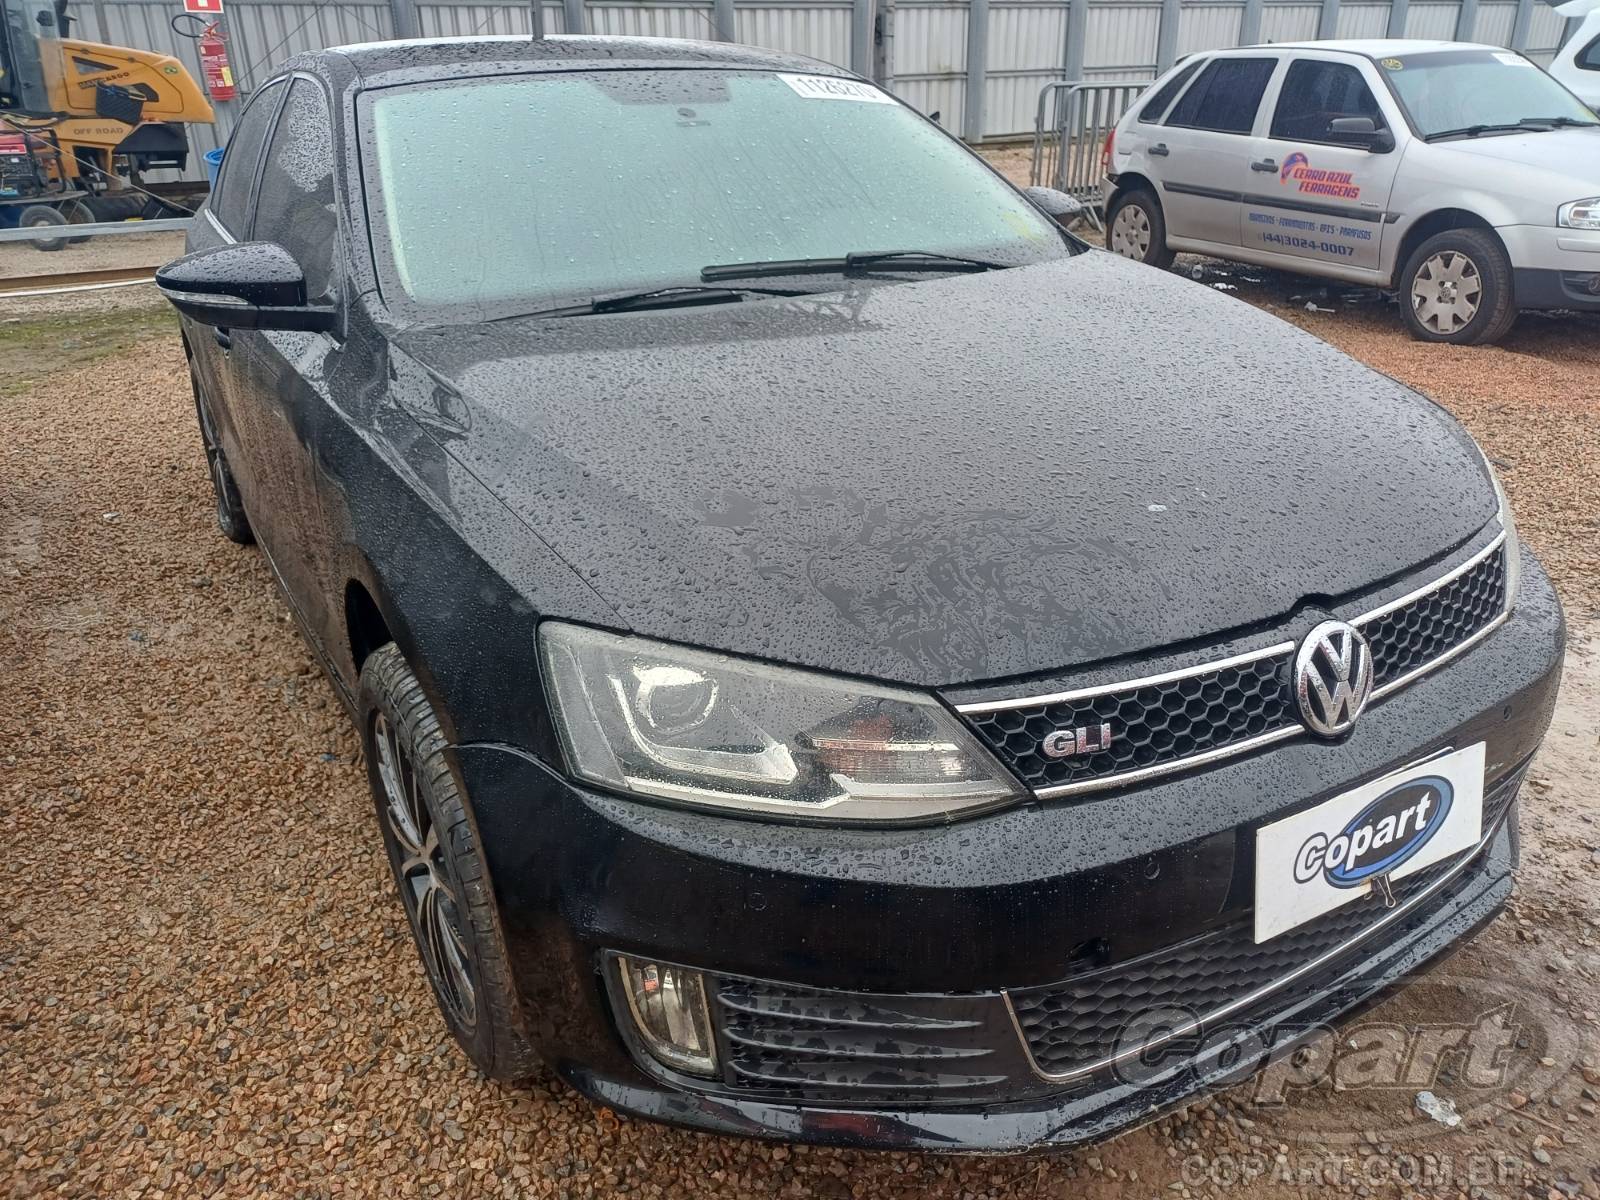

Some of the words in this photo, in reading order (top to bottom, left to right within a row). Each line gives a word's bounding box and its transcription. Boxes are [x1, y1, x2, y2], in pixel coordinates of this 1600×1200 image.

[95, 127, 124, 135] ROAD
[1293, 167, 1327, 181] CERRO
[1326, 171, 1353, 184] AZUL
[1298, 181, 1360, 199] FERRAGENS
[1262, 231, 1355, 256] (44)3024-0007
[1042, 722, 1112, 758] GLI
[1294, 791, 1432, 884] Copart
